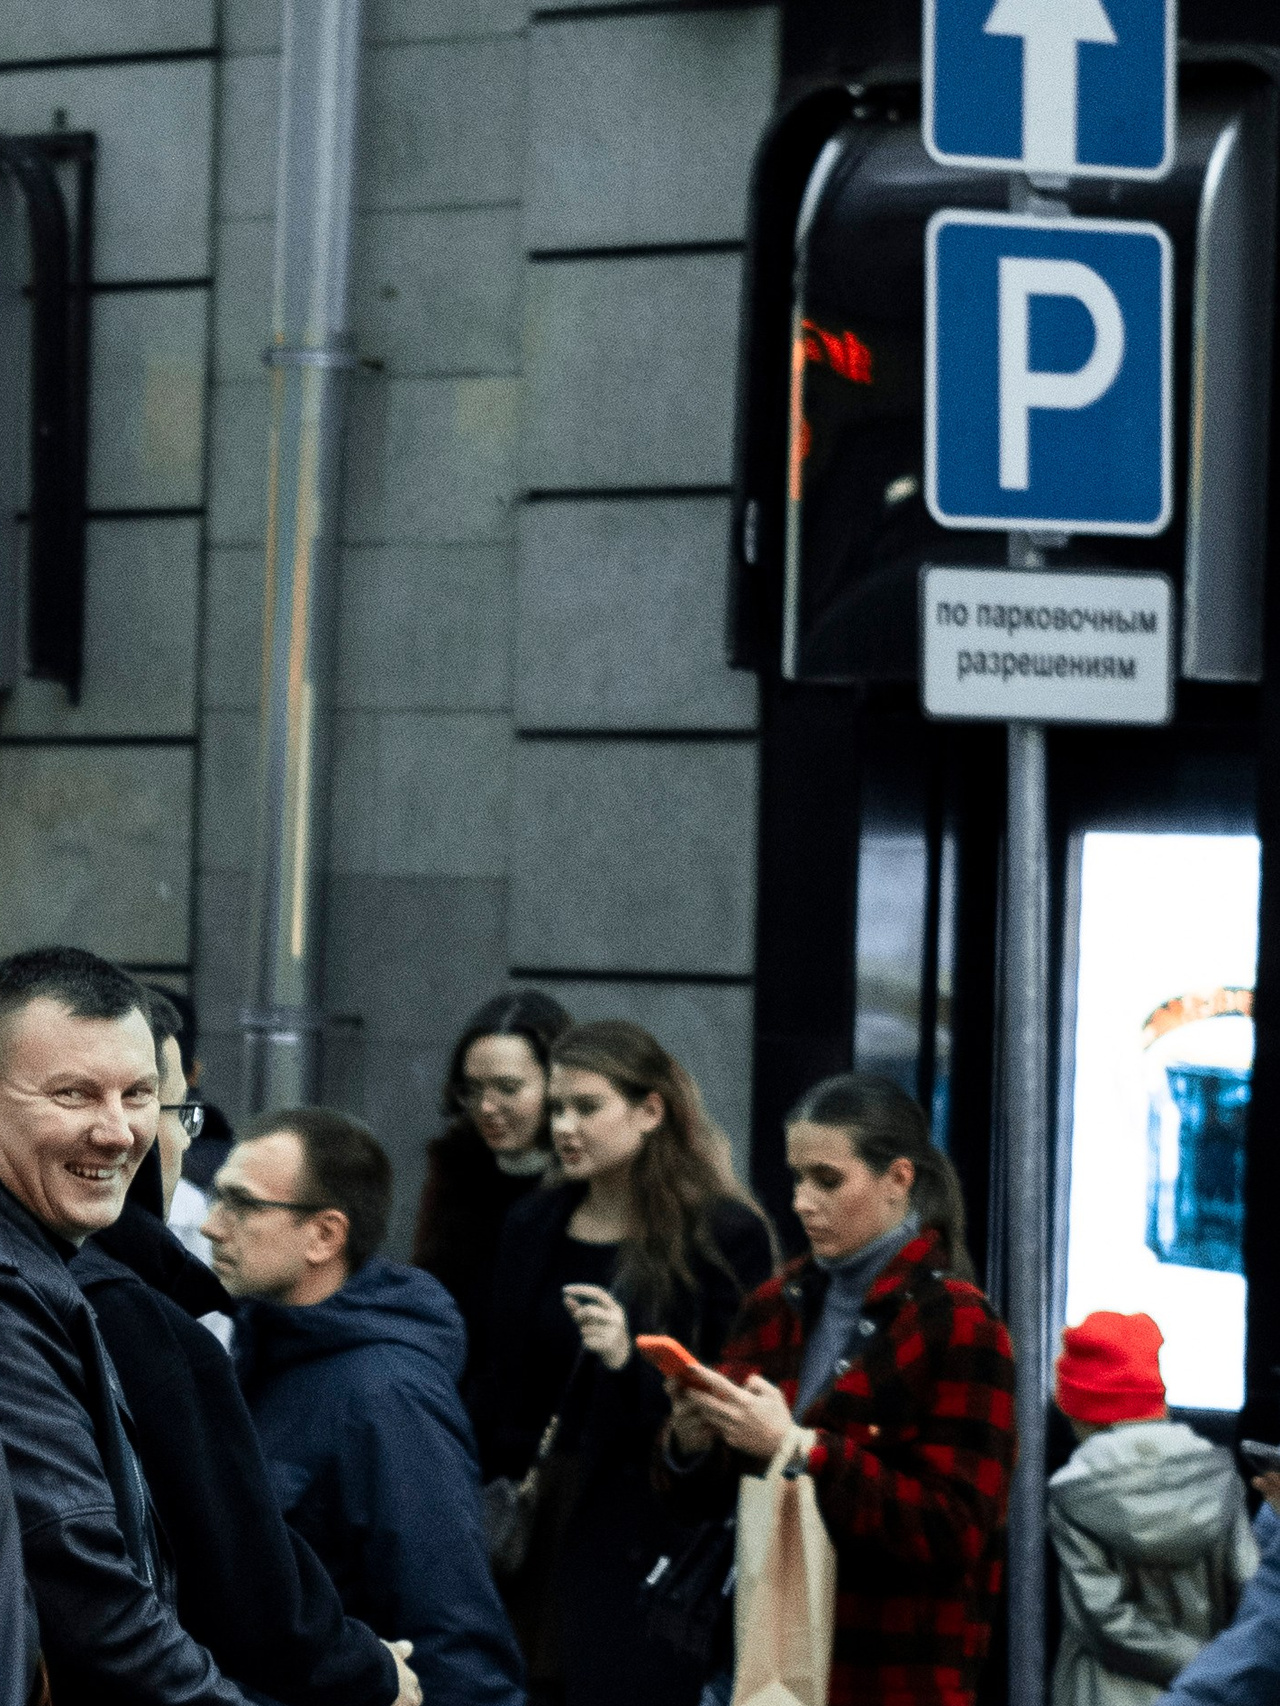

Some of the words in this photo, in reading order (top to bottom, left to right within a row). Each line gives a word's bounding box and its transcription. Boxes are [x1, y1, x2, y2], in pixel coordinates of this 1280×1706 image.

[998, 256, 1125, 492] P
[936, 602, 969, 628] по
[975, 603, 1159, 637] парковочным
[956, 650, 1137, 683] разрешениям
